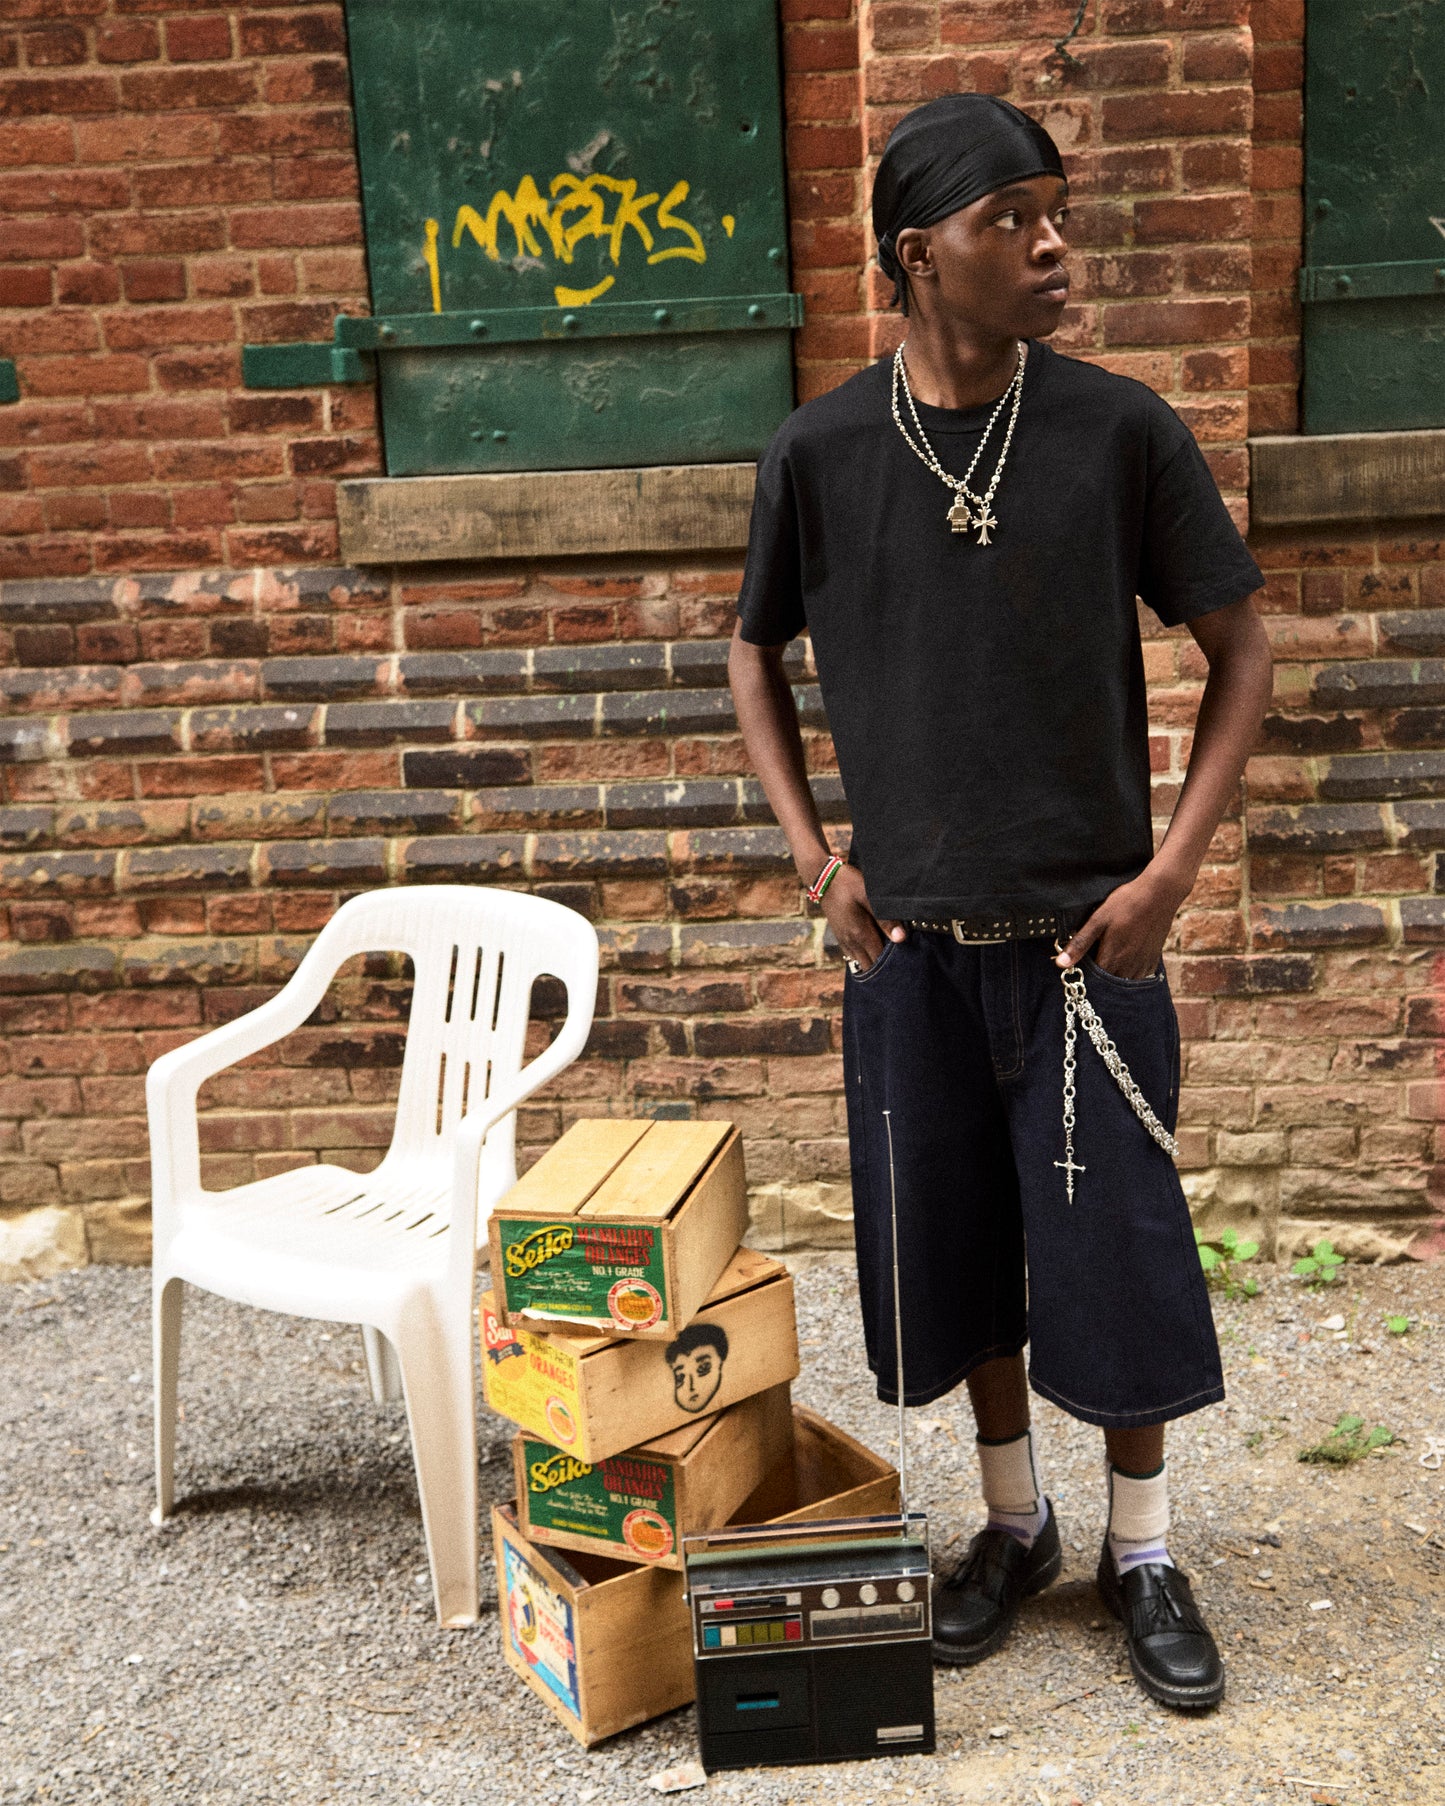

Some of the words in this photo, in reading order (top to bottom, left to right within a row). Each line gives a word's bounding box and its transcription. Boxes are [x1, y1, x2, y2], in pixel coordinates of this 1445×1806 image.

[505, 1225, 574, 1278] Seiko
[576, 1226, 655, 1248] MANDARIN
[585, 1245, 651, 1266] ORANGES
[615, 1267, 645, 1278] GRADE
[487, 1316, 513, 1345] Sun
[530, 1353, 575, 1391] ORANGES
[530, 1453, 593, 1493] Seiko
